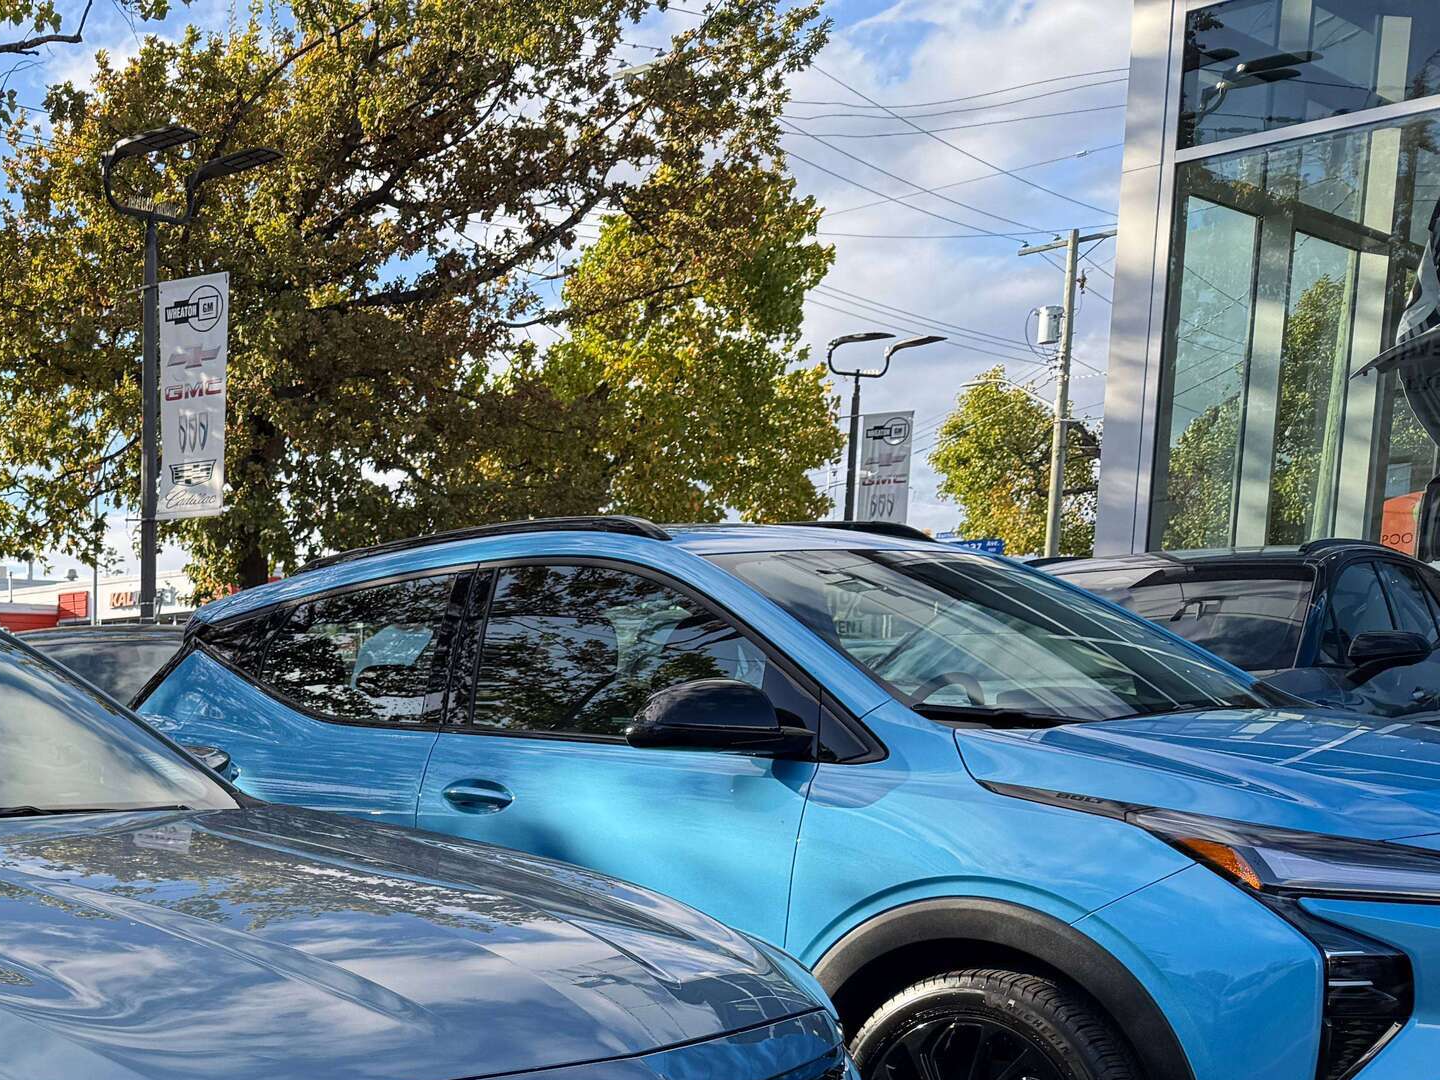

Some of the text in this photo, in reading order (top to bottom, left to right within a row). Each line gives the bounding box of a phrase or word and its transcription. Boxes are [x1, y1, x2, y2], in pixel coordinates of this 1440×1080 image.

[166, 301, 215, 322] WHEATON GM
[164, 379, 222, 401] GMC
